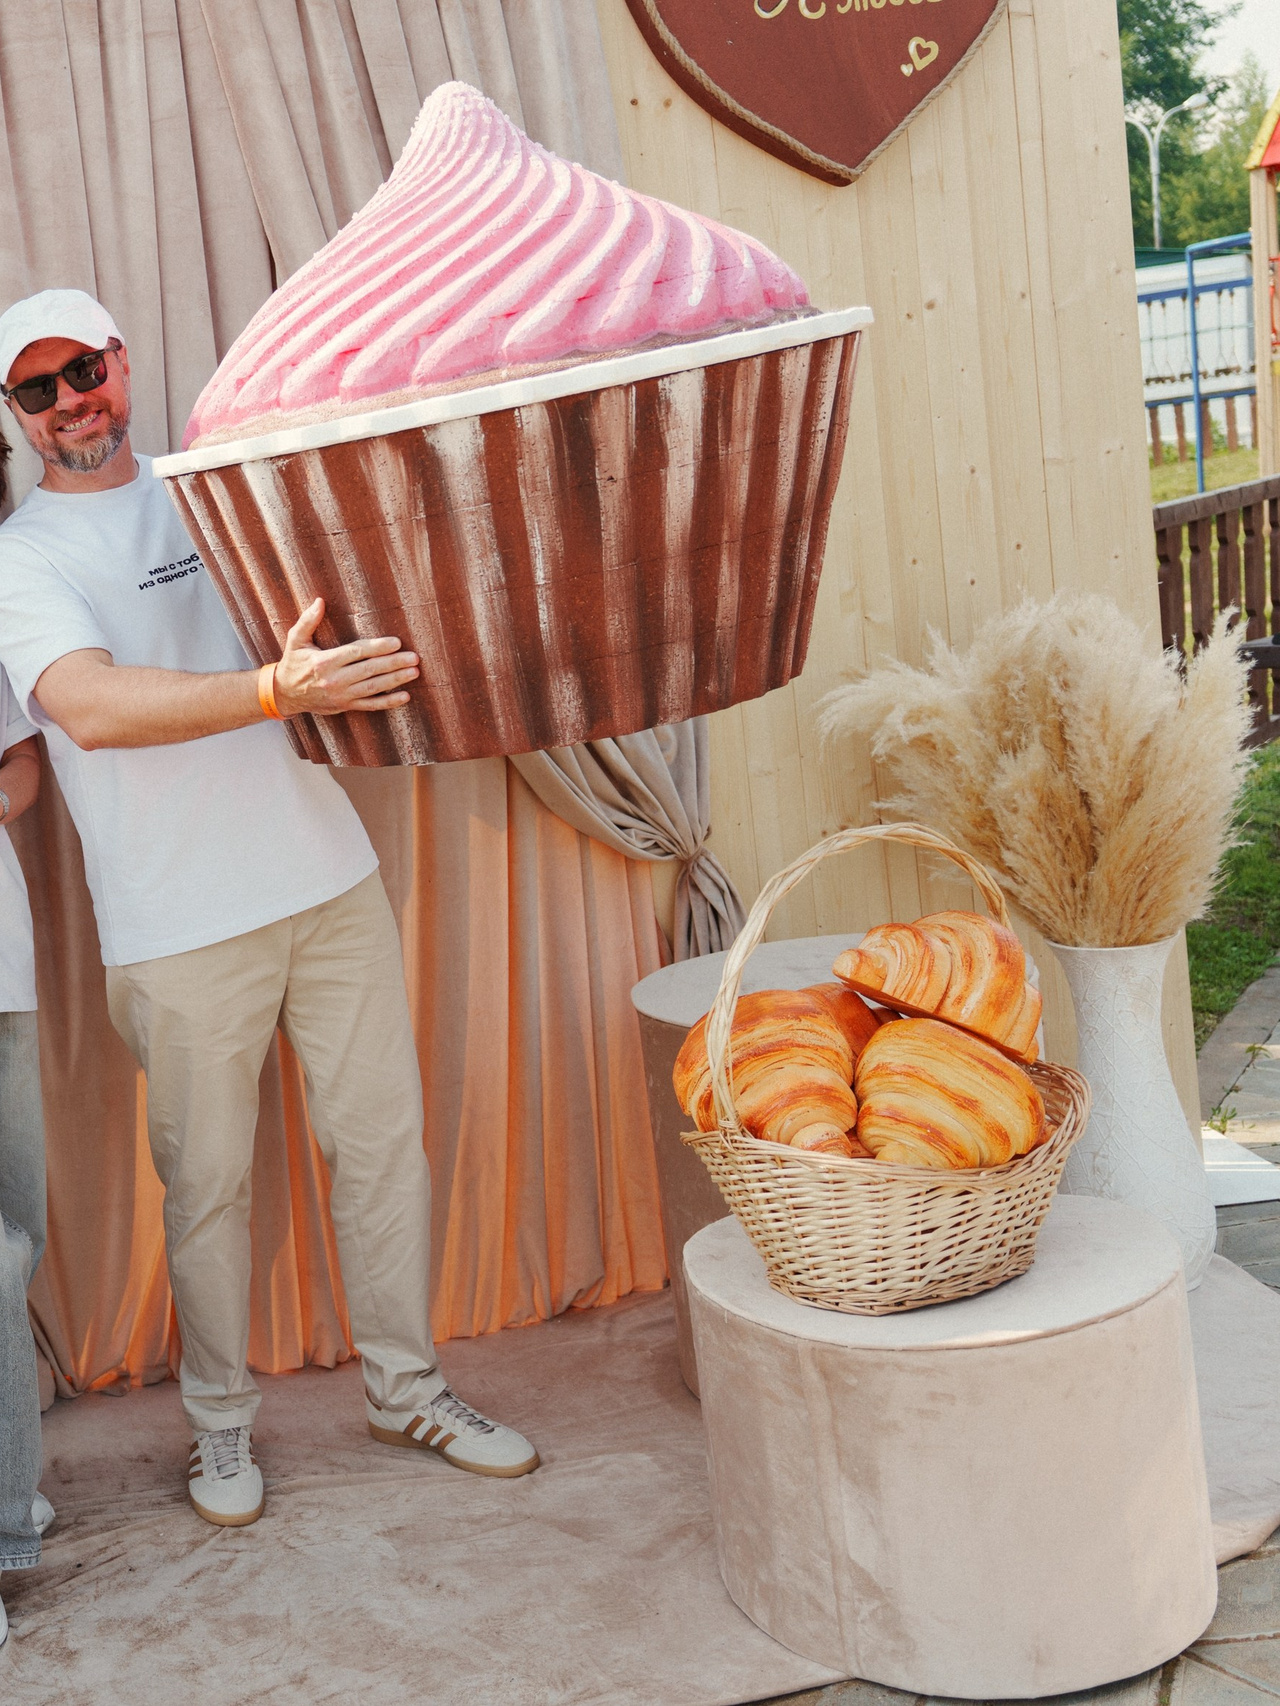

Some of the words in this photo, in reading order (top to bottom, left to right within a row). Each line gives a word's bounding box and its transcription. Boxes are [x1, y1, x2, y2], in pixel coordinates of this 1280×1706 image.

[149, 566, 168, 577] мы
[177, 552, 200, 568] тоб
[138, 580, 155, 590] из
[156, 566, 198, 584] одного
